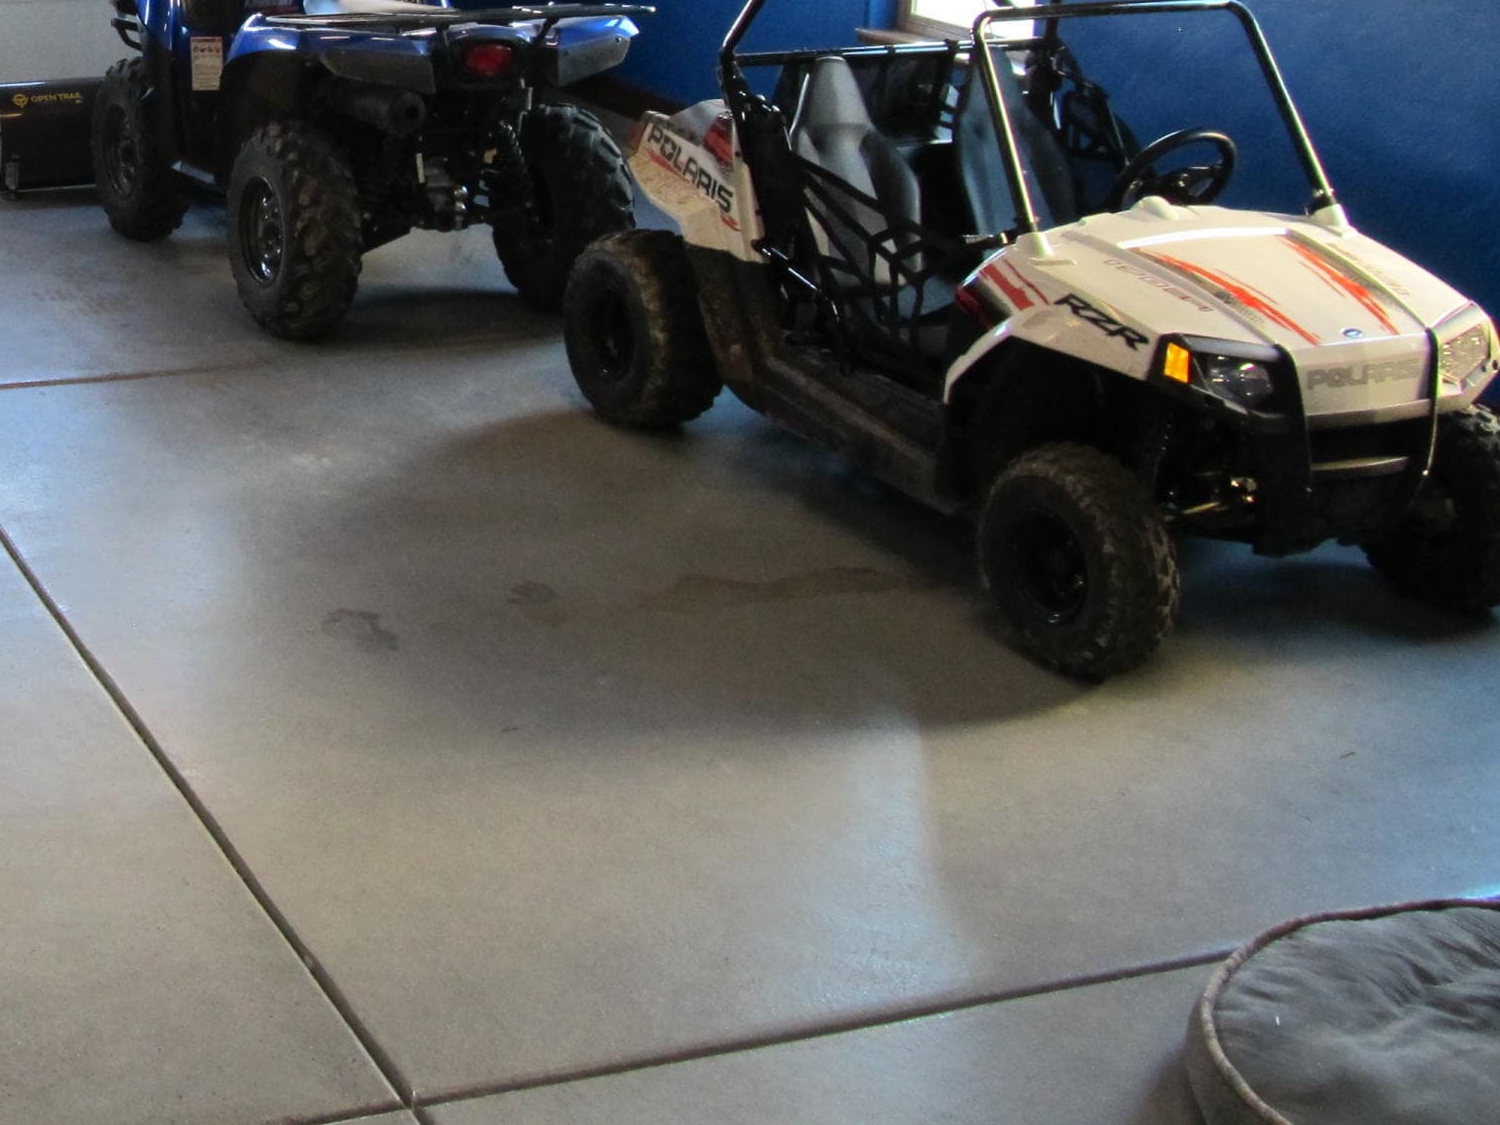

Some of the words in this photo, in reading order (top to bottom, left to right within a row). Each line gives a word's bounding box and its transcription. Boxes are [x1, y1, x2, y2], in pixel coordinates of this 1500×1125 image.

[647, 124, 734, 214] POLARIS
[1053, 293, 1150, 352] RZR
[1306, 358, 1420, 390] POLARIS
